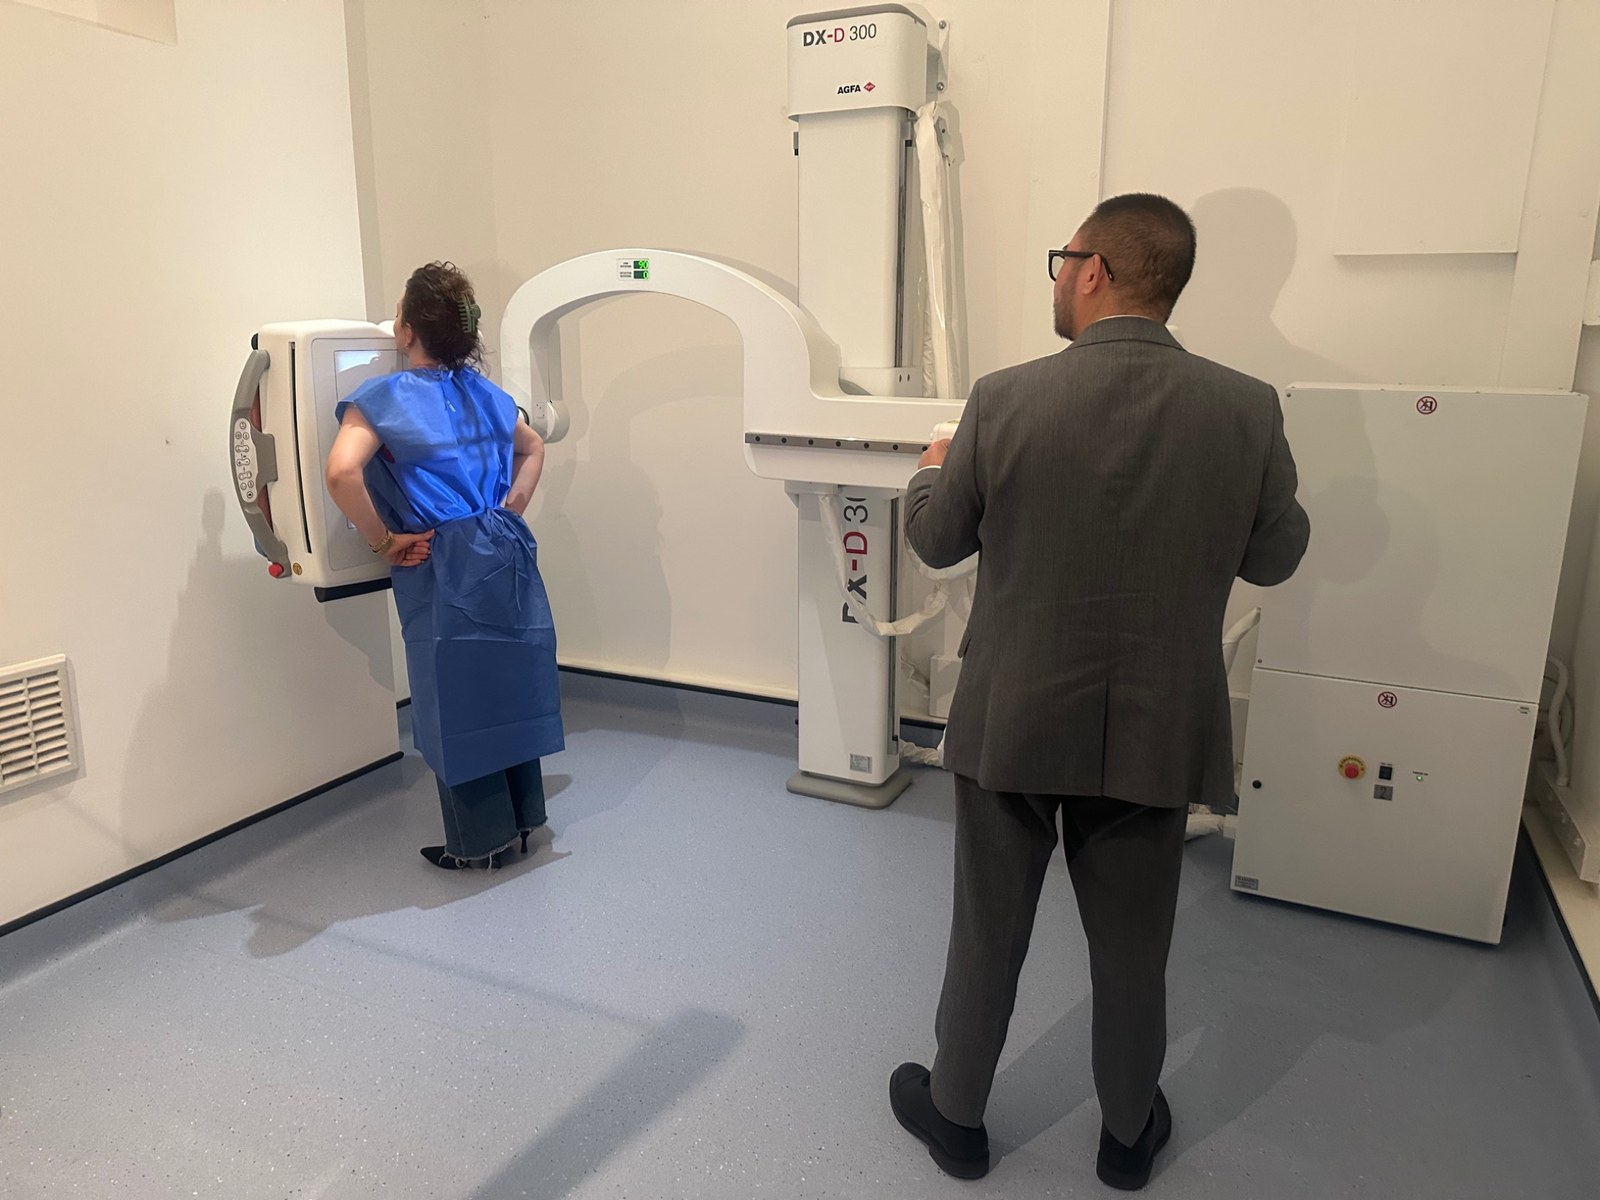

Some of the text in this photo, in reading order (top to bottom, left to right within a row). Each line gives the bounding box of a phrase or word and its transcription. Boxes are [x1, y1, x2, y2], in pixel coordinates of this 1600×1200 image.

[803, 23, 877, 46] DX-D 300
[837, 84, 861, 94] AGFA
